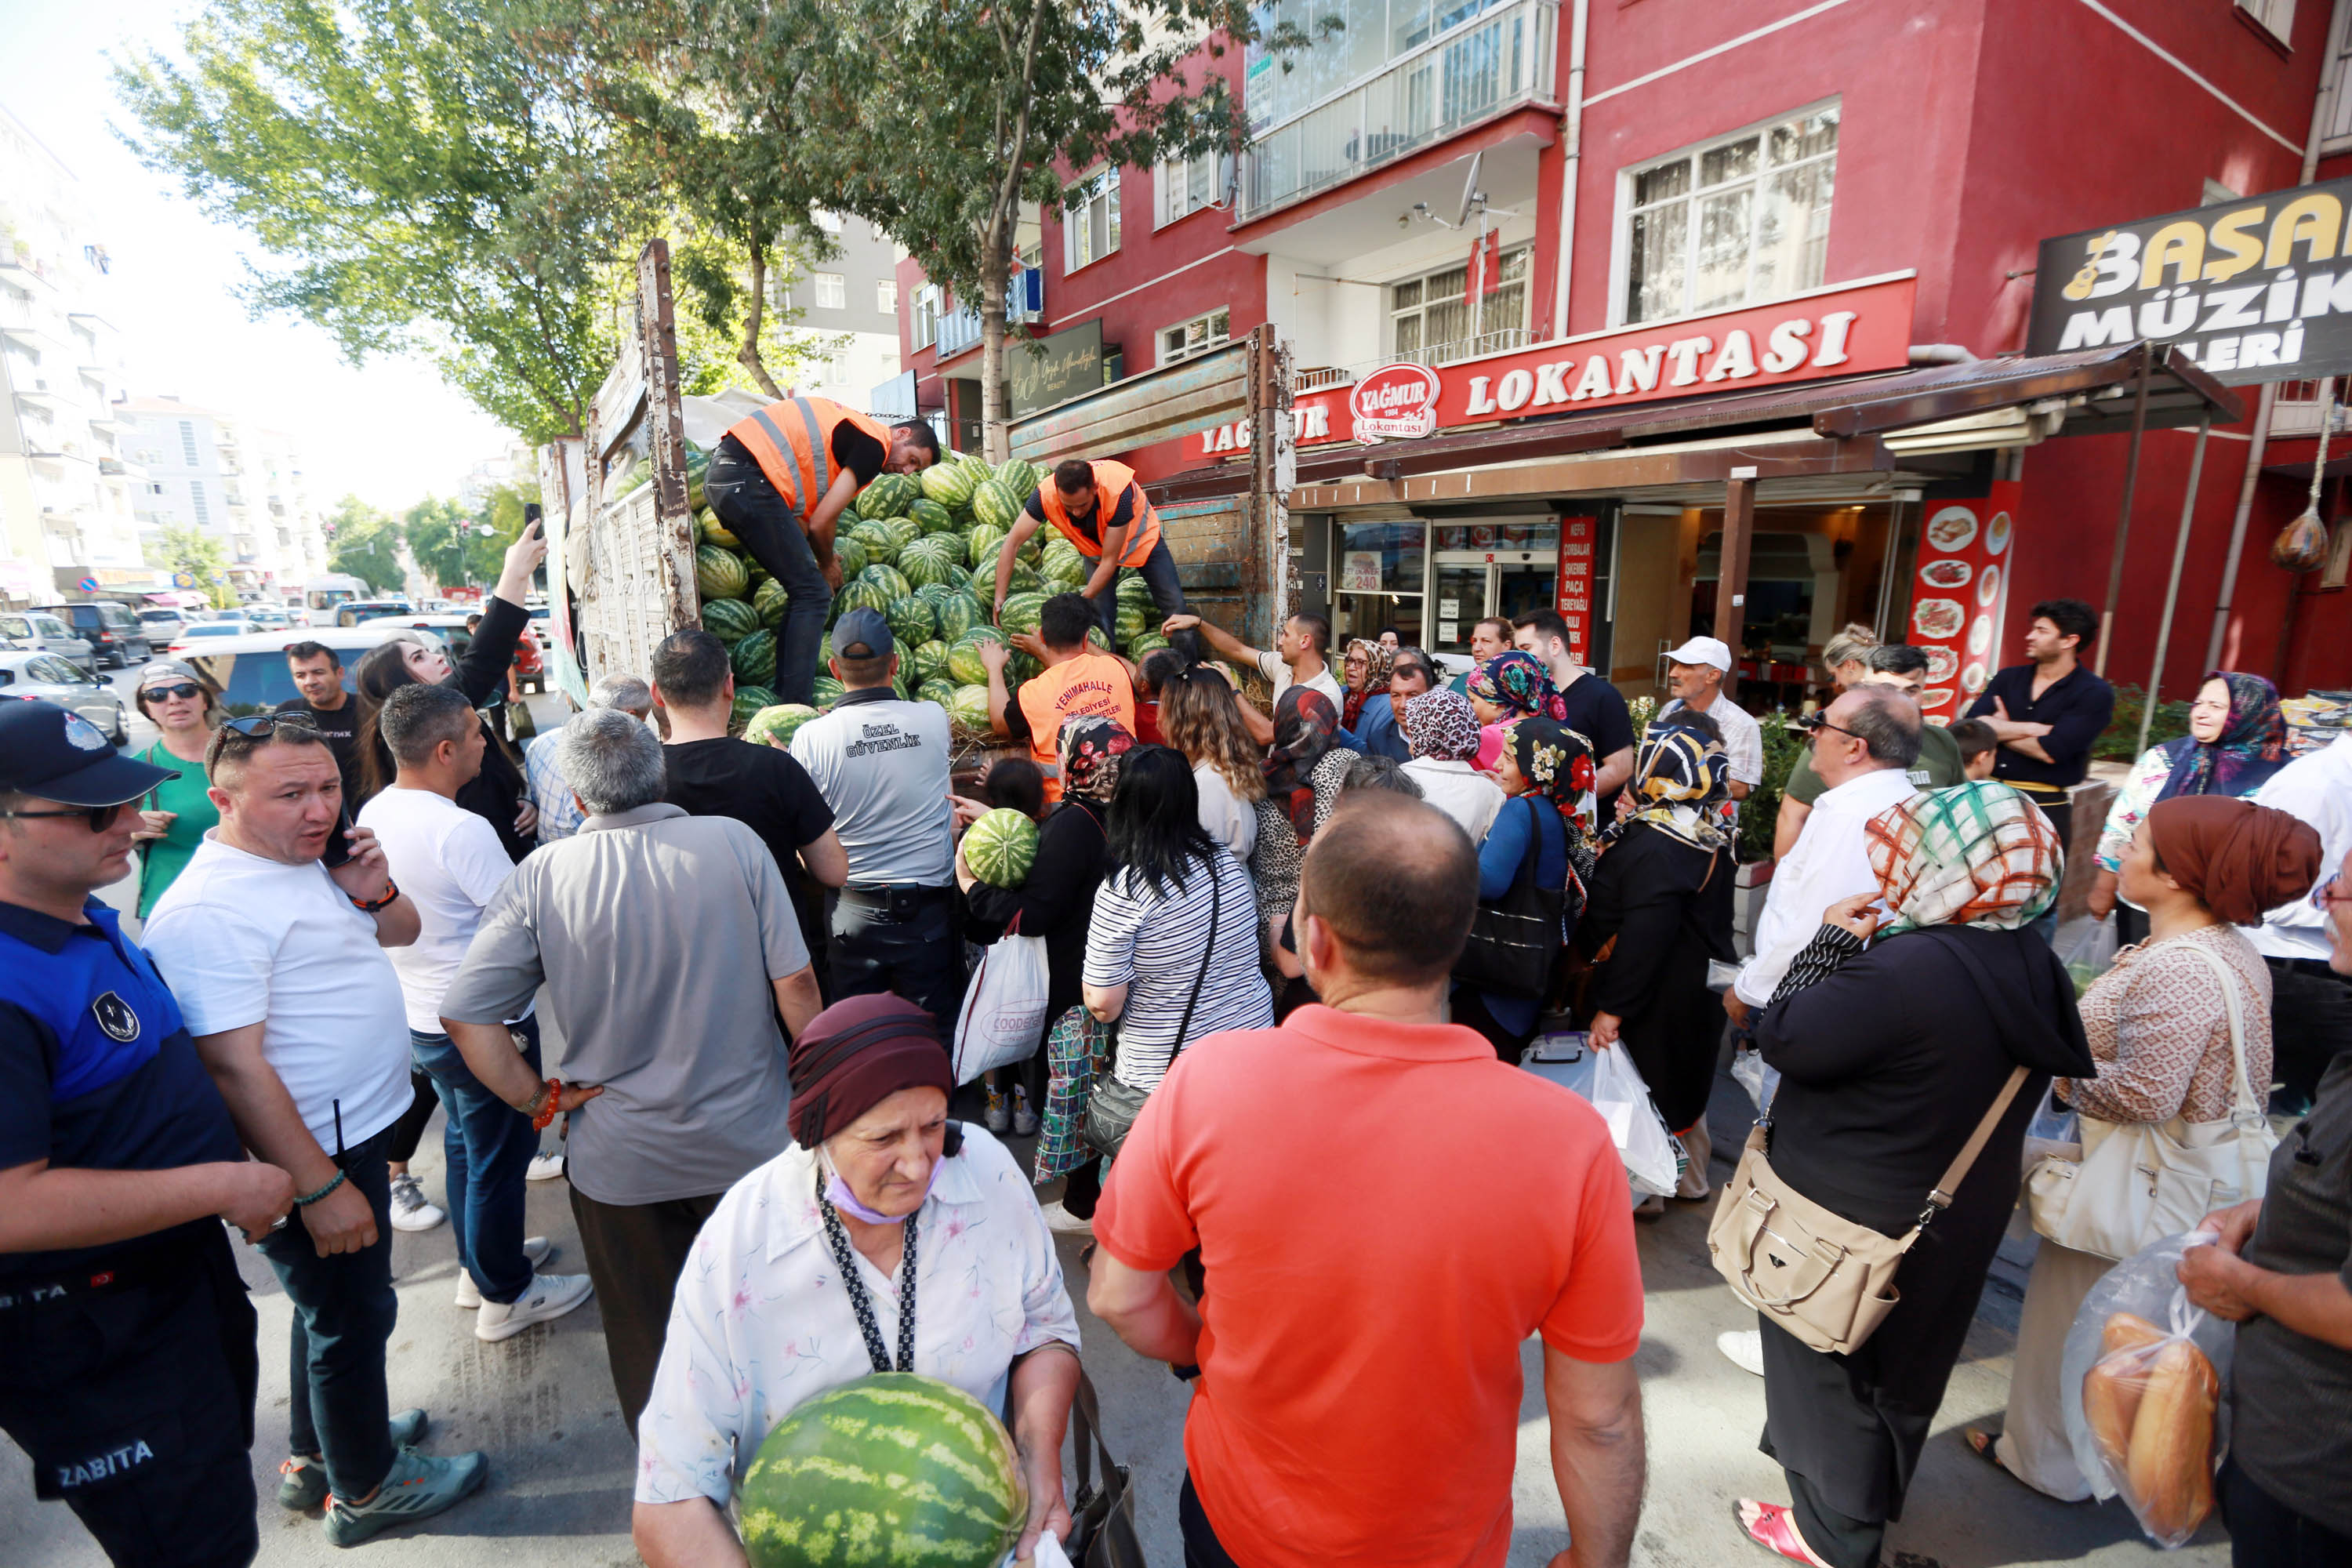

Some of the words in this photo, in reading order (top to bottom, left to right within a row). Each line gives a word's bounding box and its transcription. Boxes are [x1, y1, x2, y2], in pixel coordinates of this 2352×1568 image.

[2062, 194, 2352, 301] BAŞA
[2056, 269, 2352, 351] MÜZİK
[2172, 318, 2305, 373] LERİ
[1465, 310, 1857, 417] LOKANTASI
[1047, 379, 1067, 391] BEAUTY
[1361, 381, 1427, 412] YAĞMUR
[1361, 419, 1422, 434] Lokantası
[1563, 543, 1591, 559] ÇORBALAR
[1565, 561, 1588, 579] İŞKEMBE
[1356, 575, 1377, 590] 240
[1565, 580, 1584, 596] PAÇA
[1561, 596, 1588, 612] TEREYAĞLI
[1566, 615, 1581, 629] SULU
[1568, 630, 1581, 644] MEK
[1569, 649, 1584, 666] TLERİ
[1054, 680, 1113, 711] YENİMAHALLE
[862, 723, 899, 739] ÖZEL
[846, 732, 921, 758] GÜVENLİK
[58, 1439, 154, 1488] ZABITA
